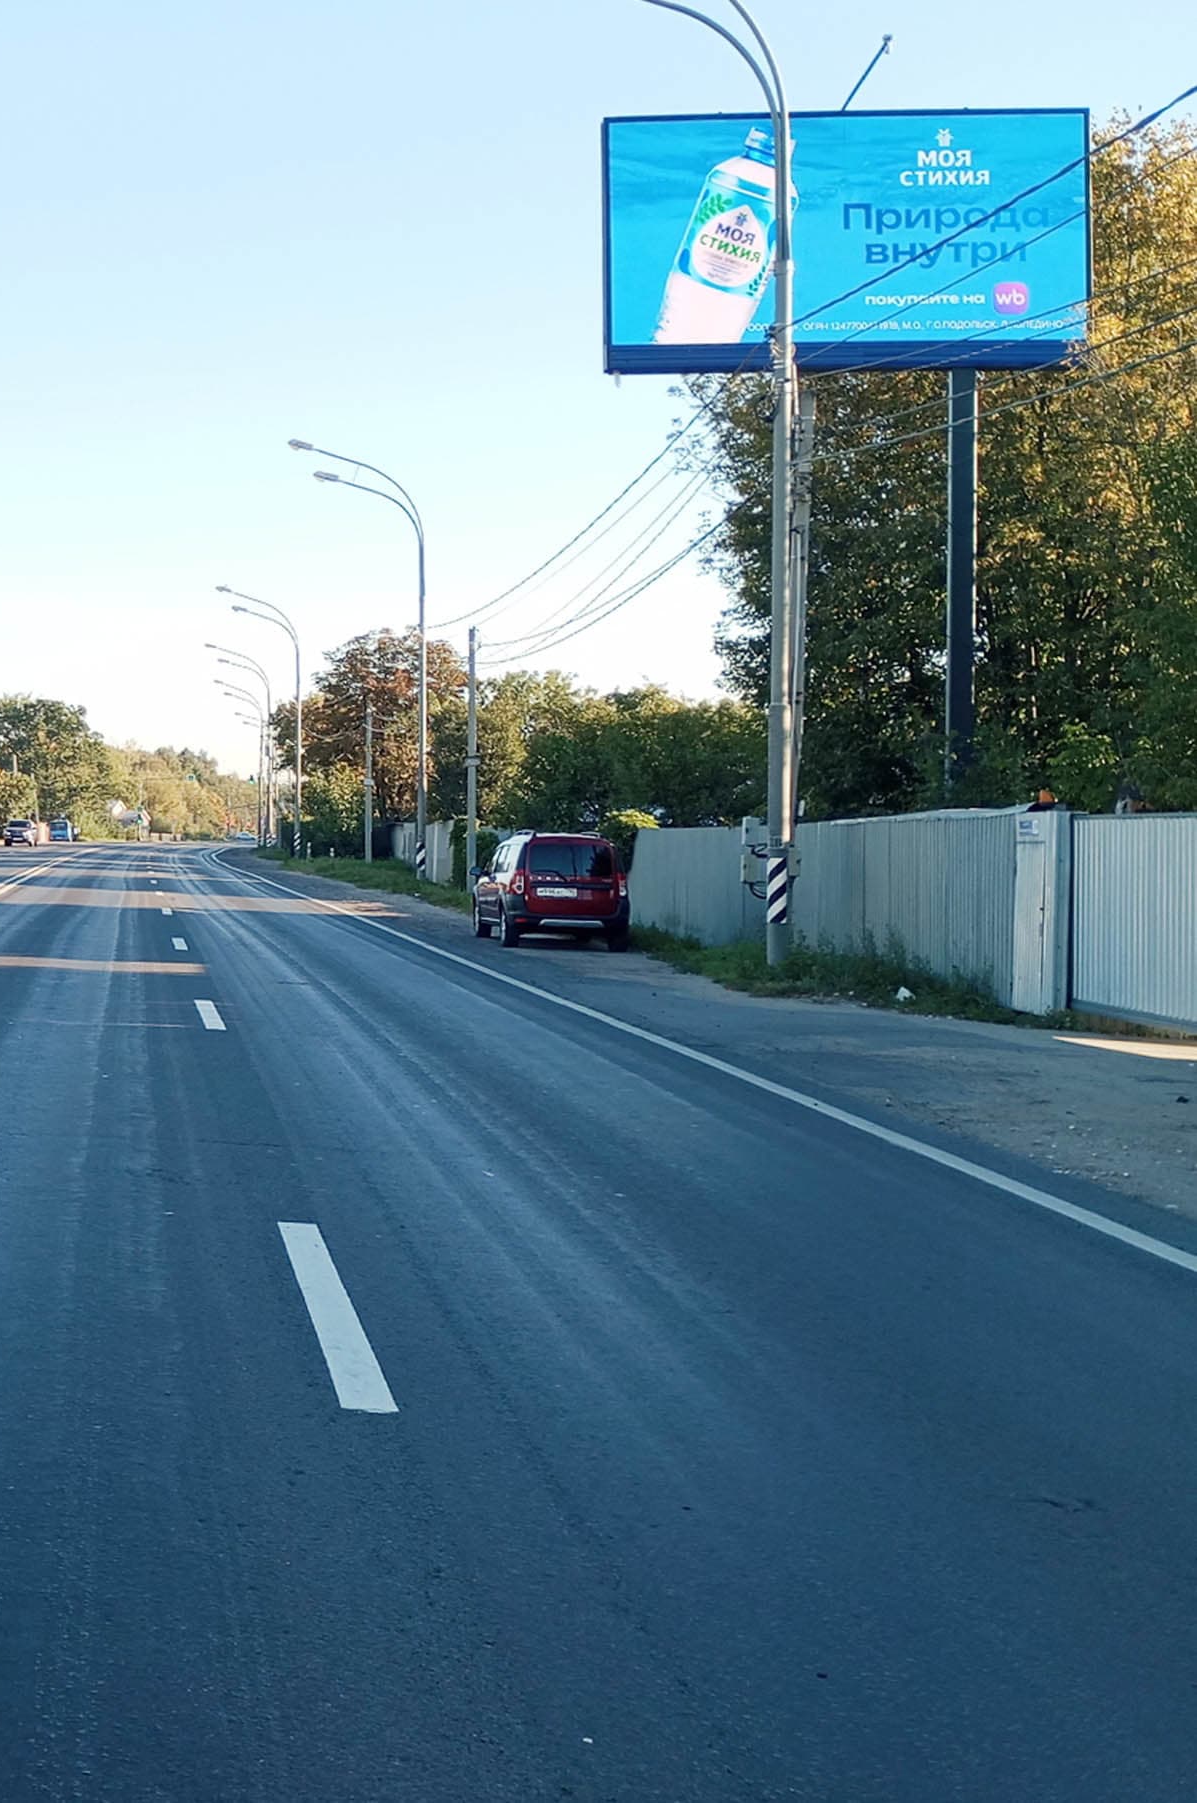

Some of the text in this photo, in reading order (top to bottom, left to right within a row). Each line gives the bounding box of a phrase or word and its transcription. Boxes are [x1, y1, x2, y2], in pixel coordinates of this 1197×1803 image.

[917, 149, 972, 168] МОЯ
[900, 170, 990, 187] СТИХИЯ
[842, 202, 1050, 235] Природа
[714, 223, 757, 246] МОЯ
[699, 233, 762, 264] СТИХИЯ
[864, 241, 1027, 269] внутри
[864, 293, 985, 307] покупайте на
[995, 291, 1026, 306] wb
